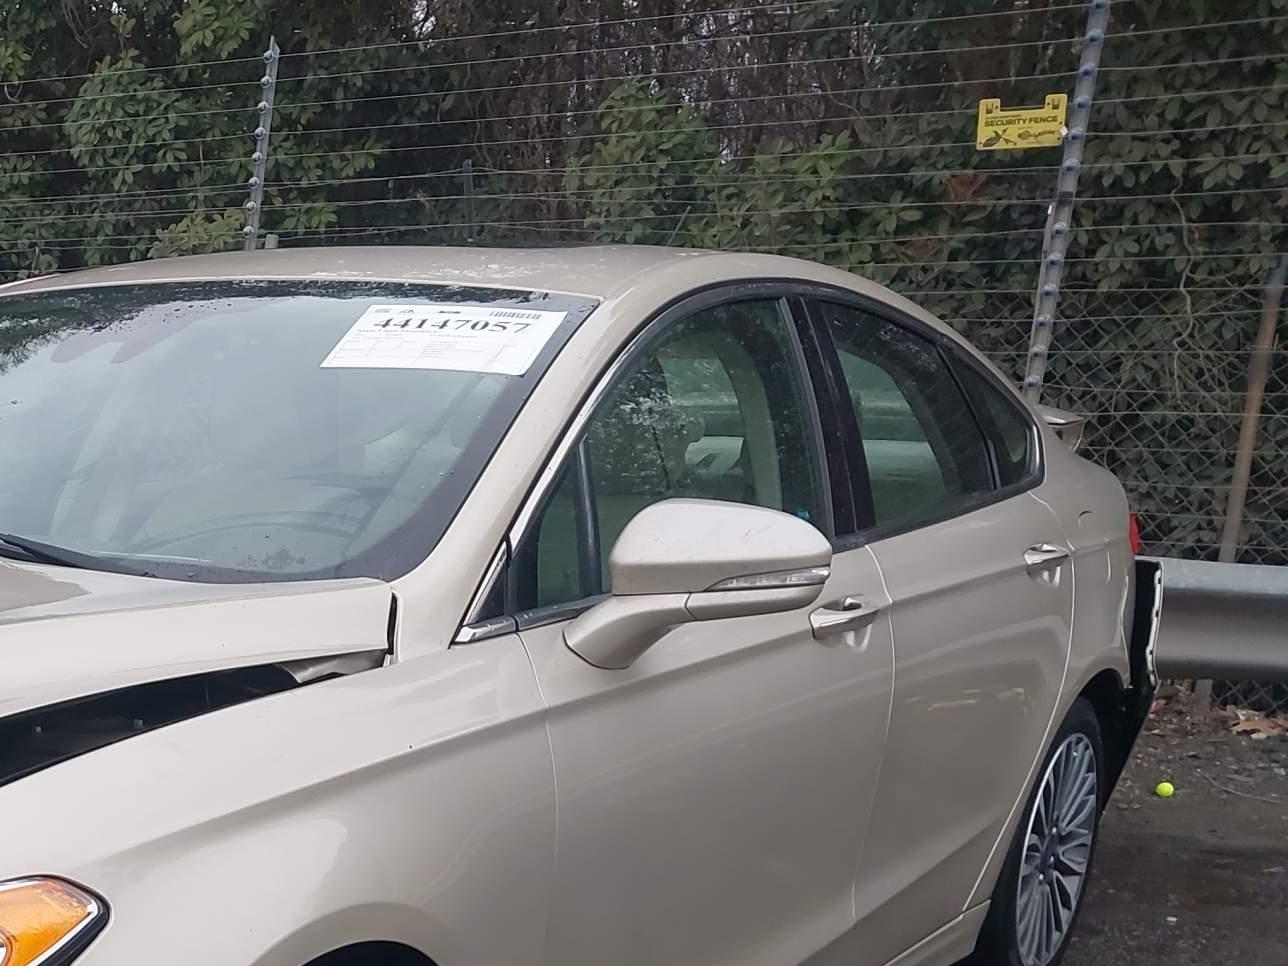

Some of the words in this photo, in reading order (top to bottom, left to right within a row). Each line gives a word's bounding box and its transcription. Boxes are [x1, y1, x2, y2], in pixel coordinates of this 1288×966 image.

[984, 117, 1028, 127] SECURITY
[1028, 115, 1058, 124] FENCE
[373, 316, 532, 335] 44147057
